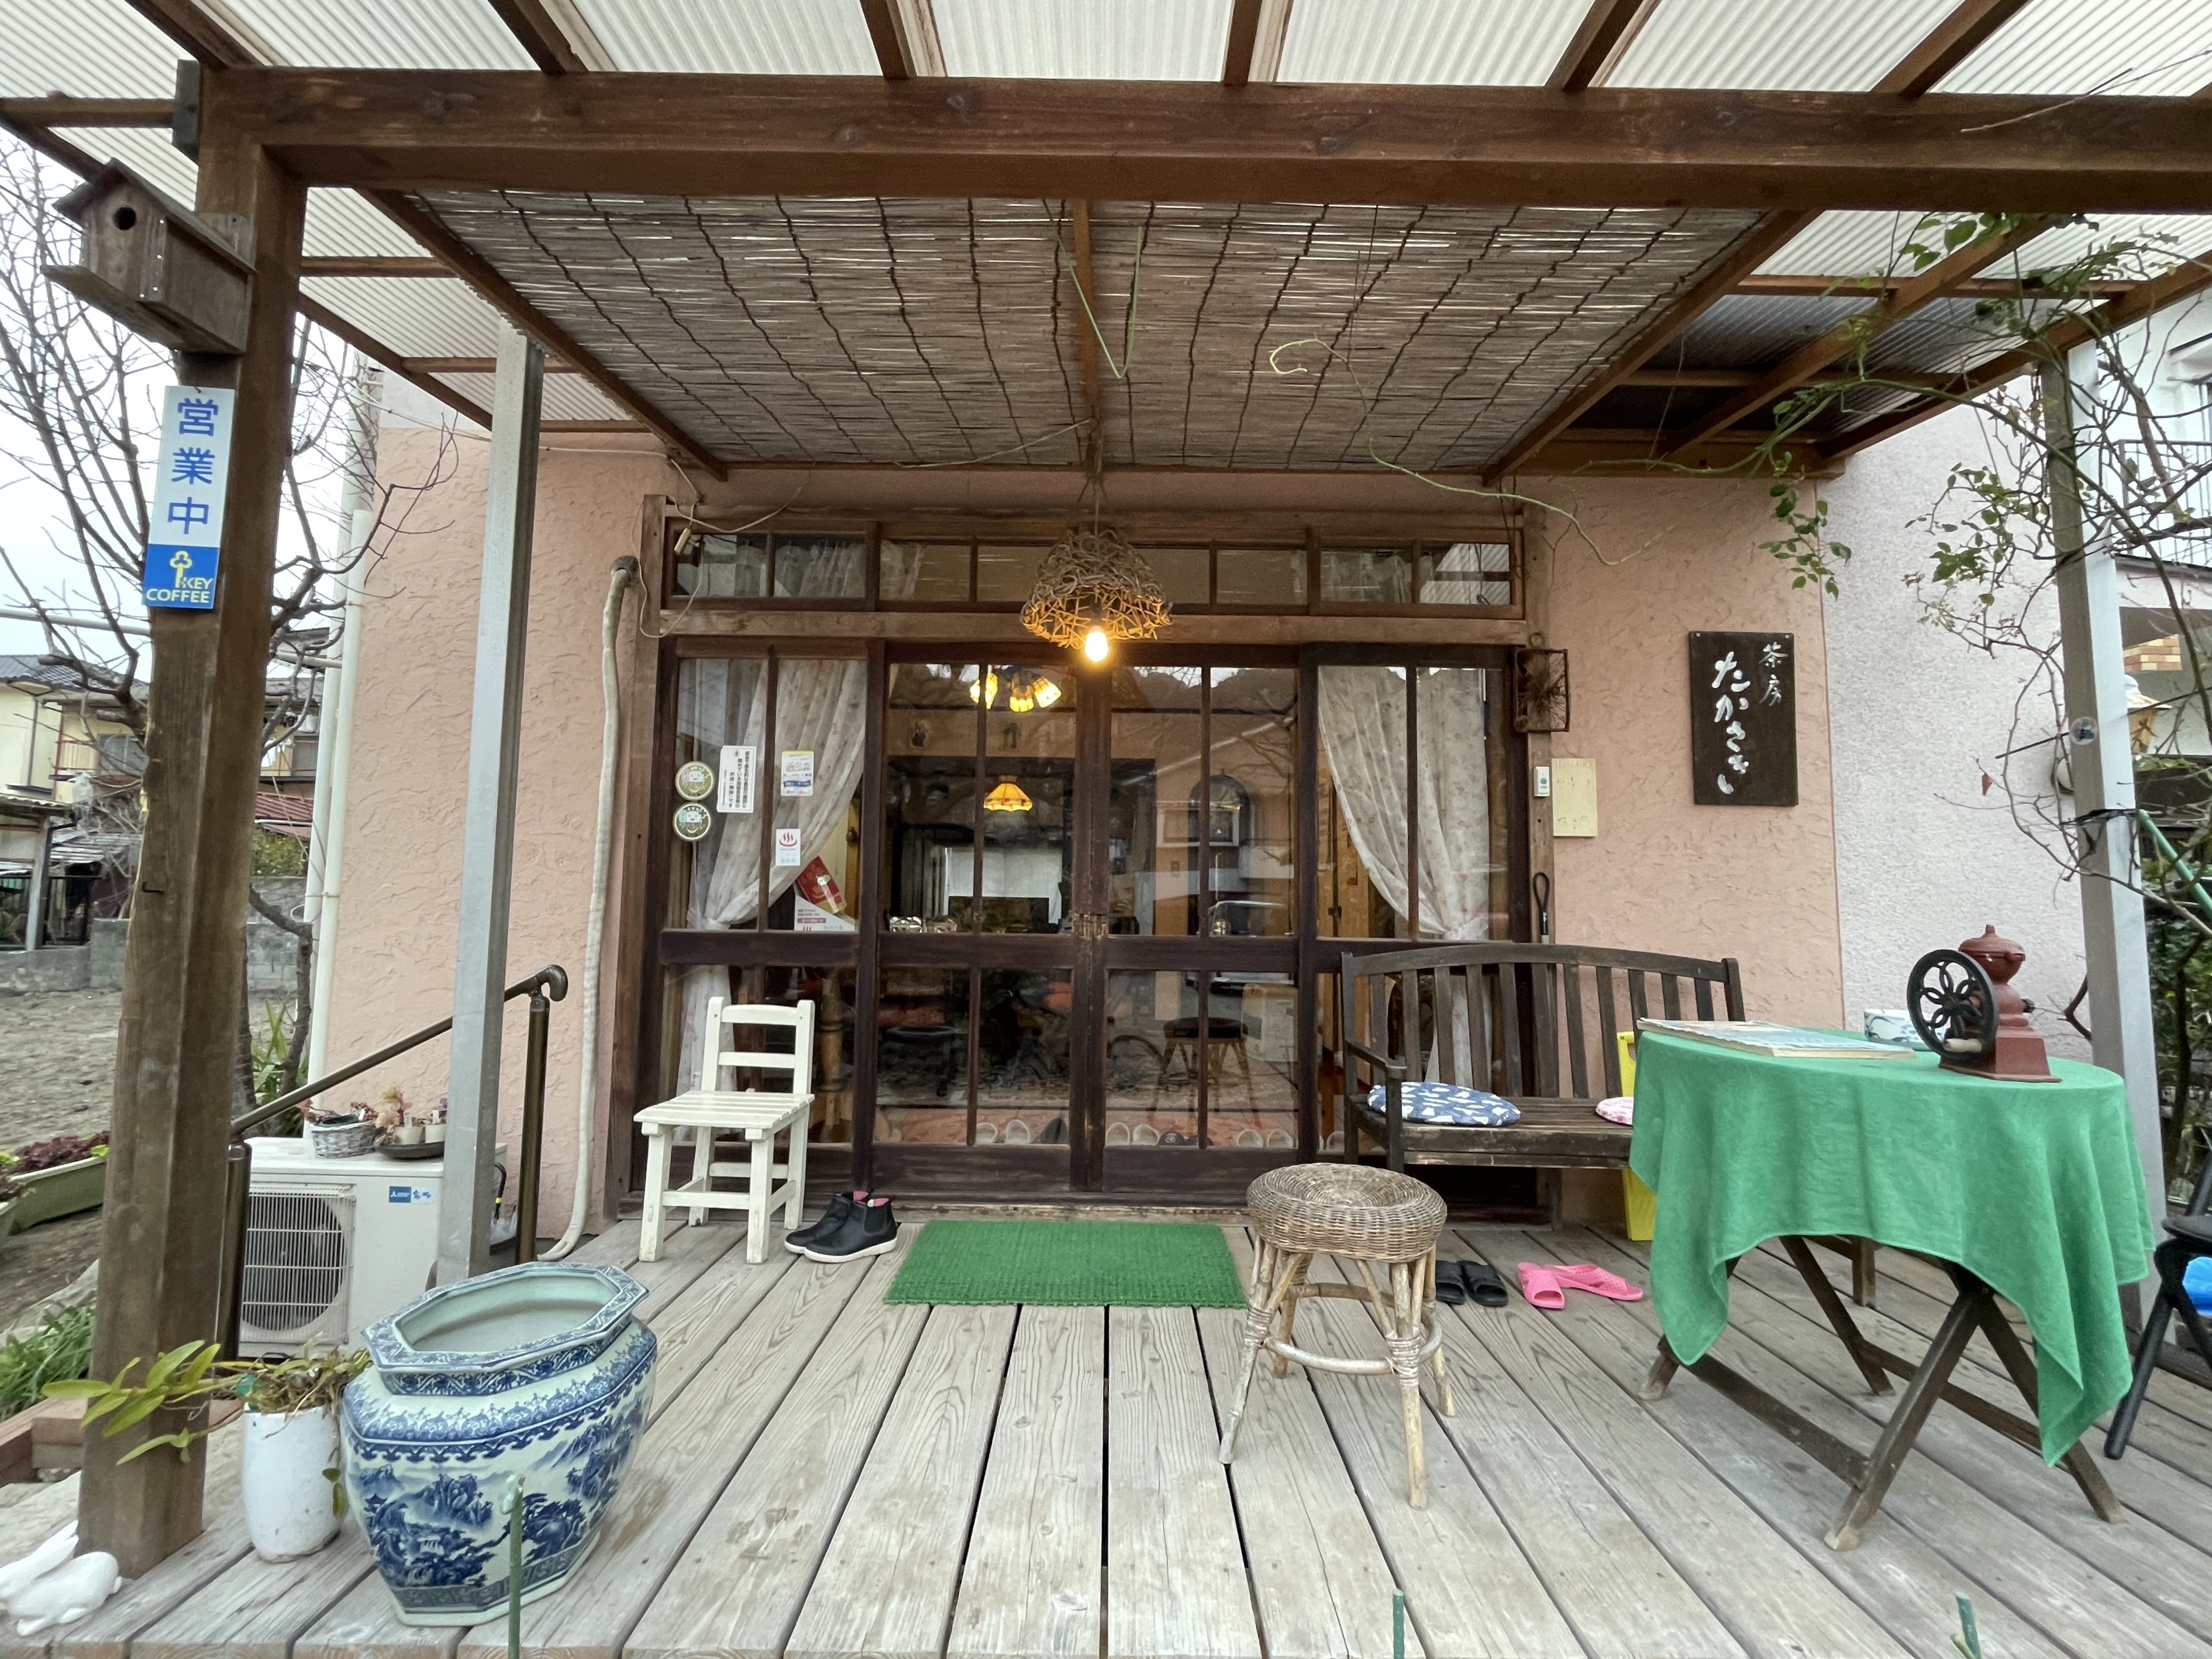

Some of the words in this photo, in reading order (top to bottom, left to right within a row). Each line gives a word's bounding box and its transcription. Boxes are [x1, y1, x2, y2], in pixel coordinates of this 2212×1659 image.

[167, 398, 219, 535] 営業中
[146, 588, 210, 603] COFFEE
[182, 577, 213, 589] KEY
[1758, 641, 1788, 707] 茶房
